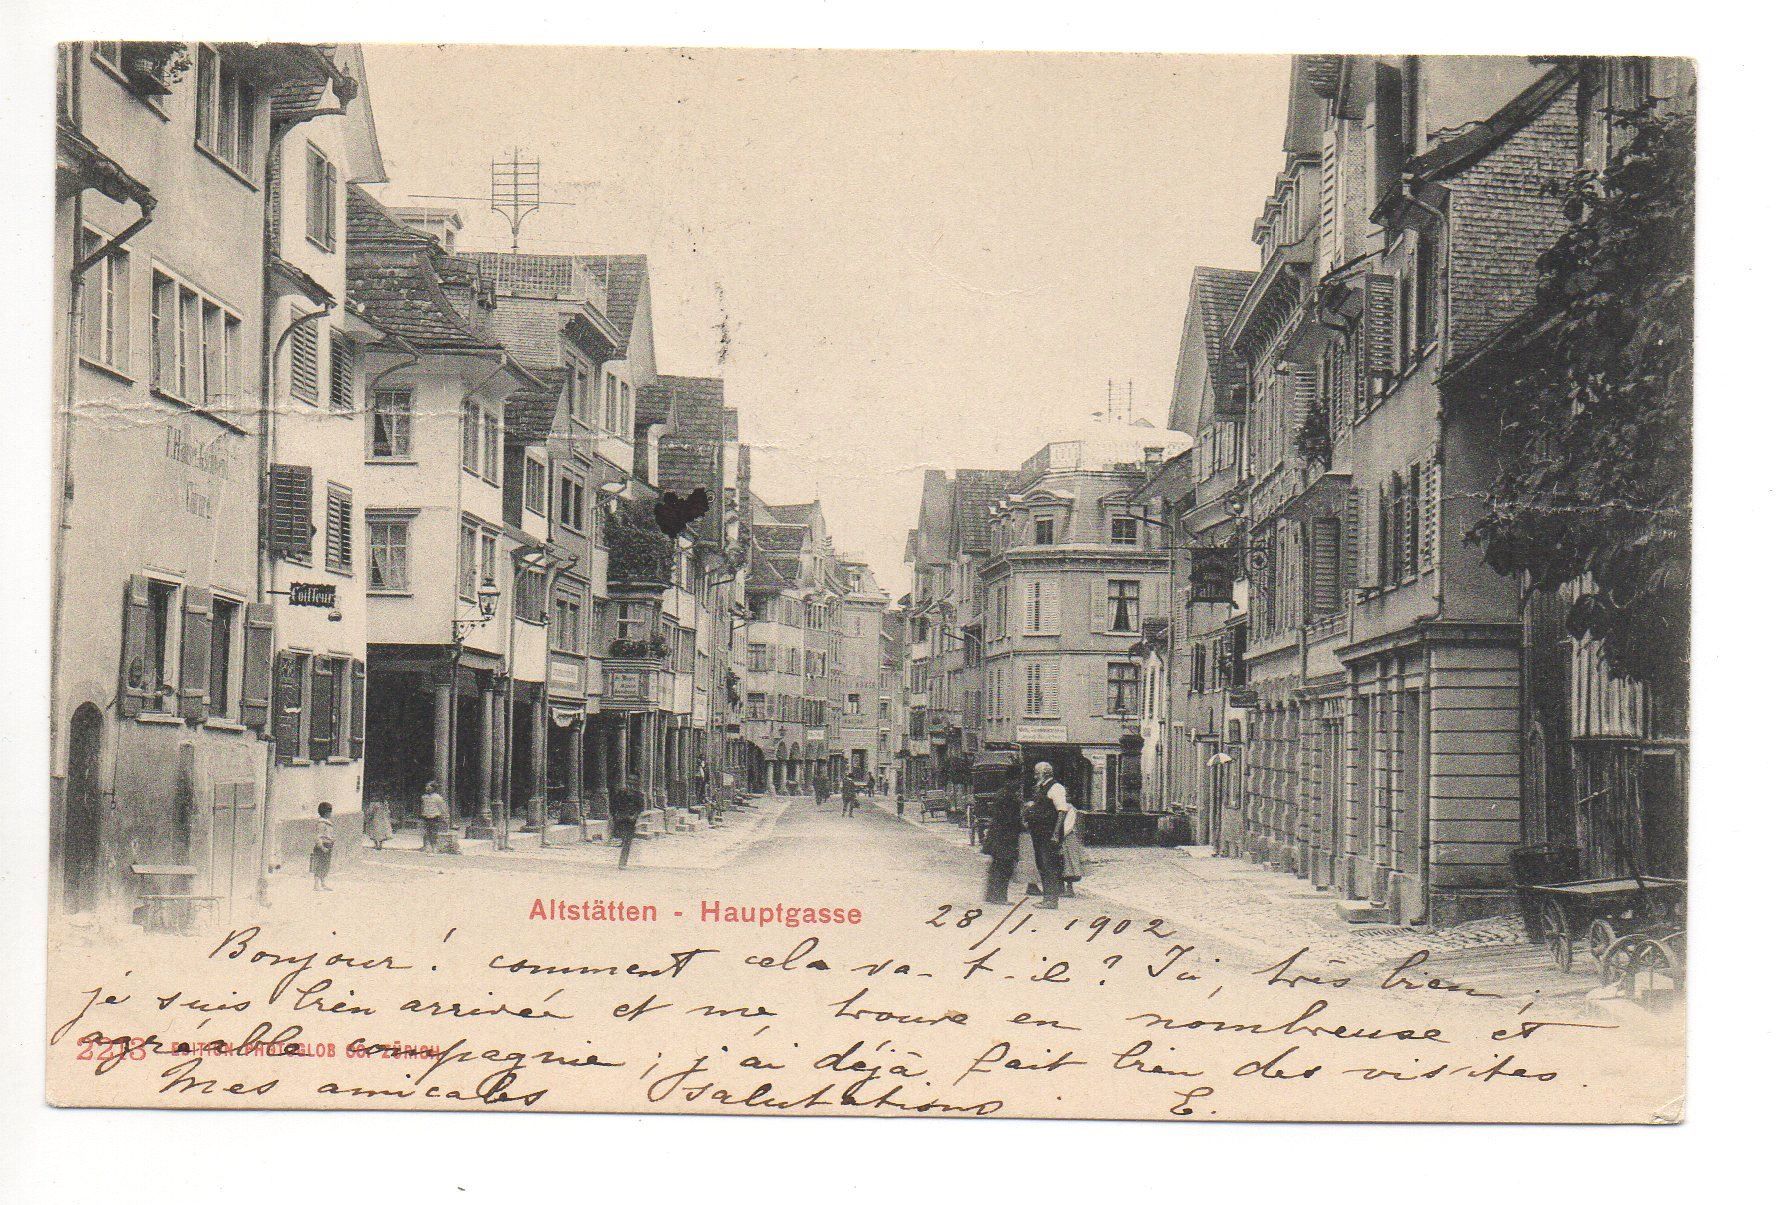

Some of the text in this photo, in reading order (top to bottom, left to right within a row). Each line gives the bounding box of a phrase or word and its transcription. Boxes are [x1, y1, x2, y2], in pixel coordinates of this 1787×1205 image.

[488, 948, 721, 978] comment
[744, 936, 831, 971] cela
[156, 990, 252, 1012] suis
[293, 978, 377, 1016] bien
[612, 994, 674, 1022] et
[1006, 1012, 1082, 1031] en
[158, 1057, 281, 1094] Mes
[1232, 1045, 1323, 1080] des
